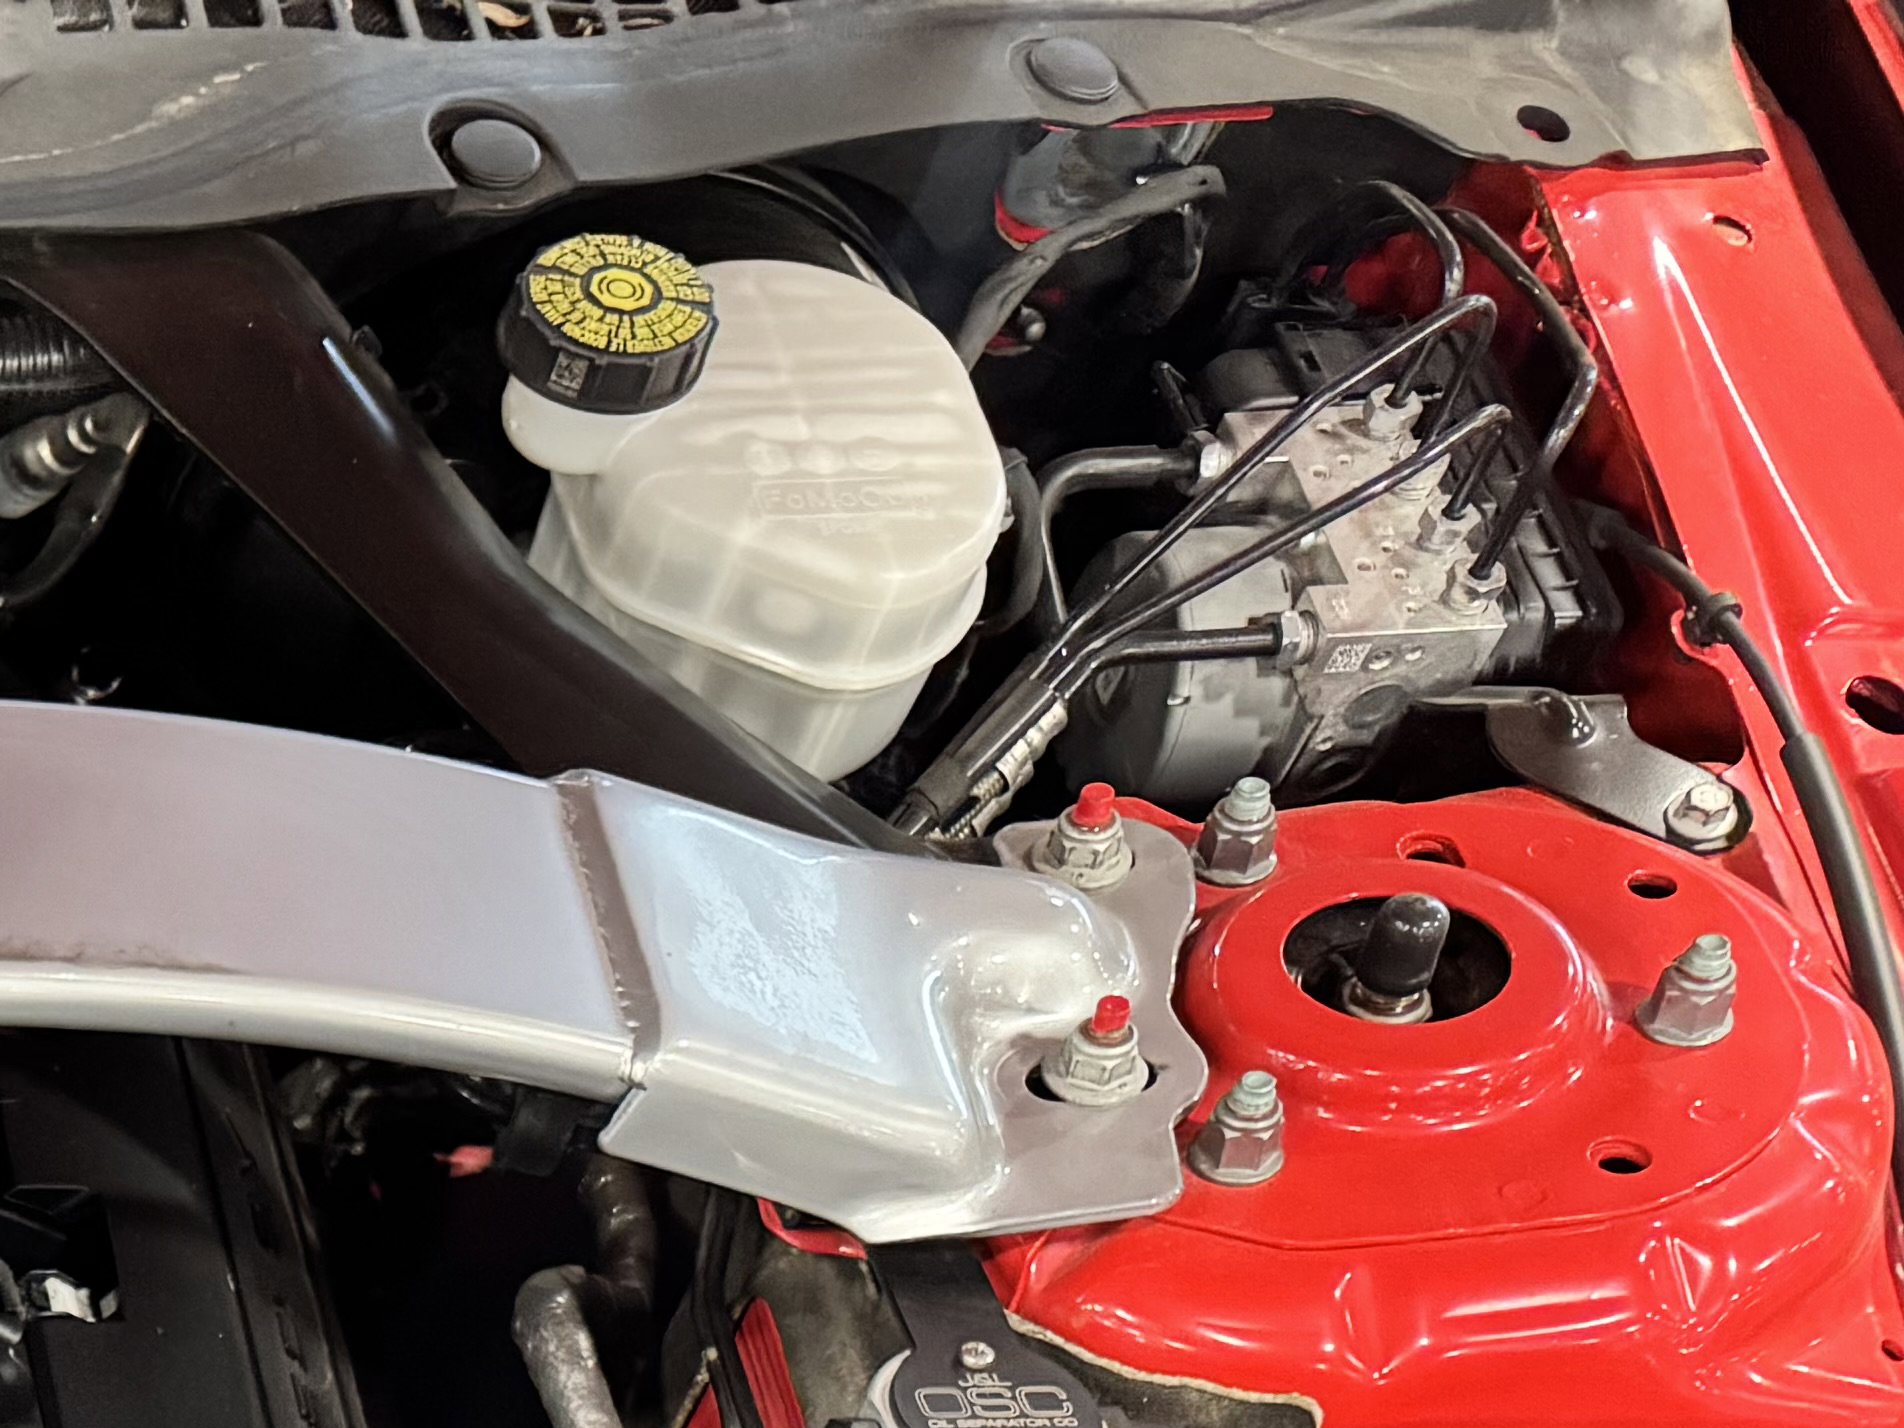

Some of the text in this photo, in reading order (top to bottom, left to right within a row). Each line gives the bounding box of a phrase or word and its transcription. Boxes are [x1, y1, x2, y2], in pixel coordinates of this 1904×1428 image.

[957, 1372, 1013, 1388] J&L
[914, 1385, 1074, 1419] OSC
[956, 1416, 1052, 1428] SEPARATOR
